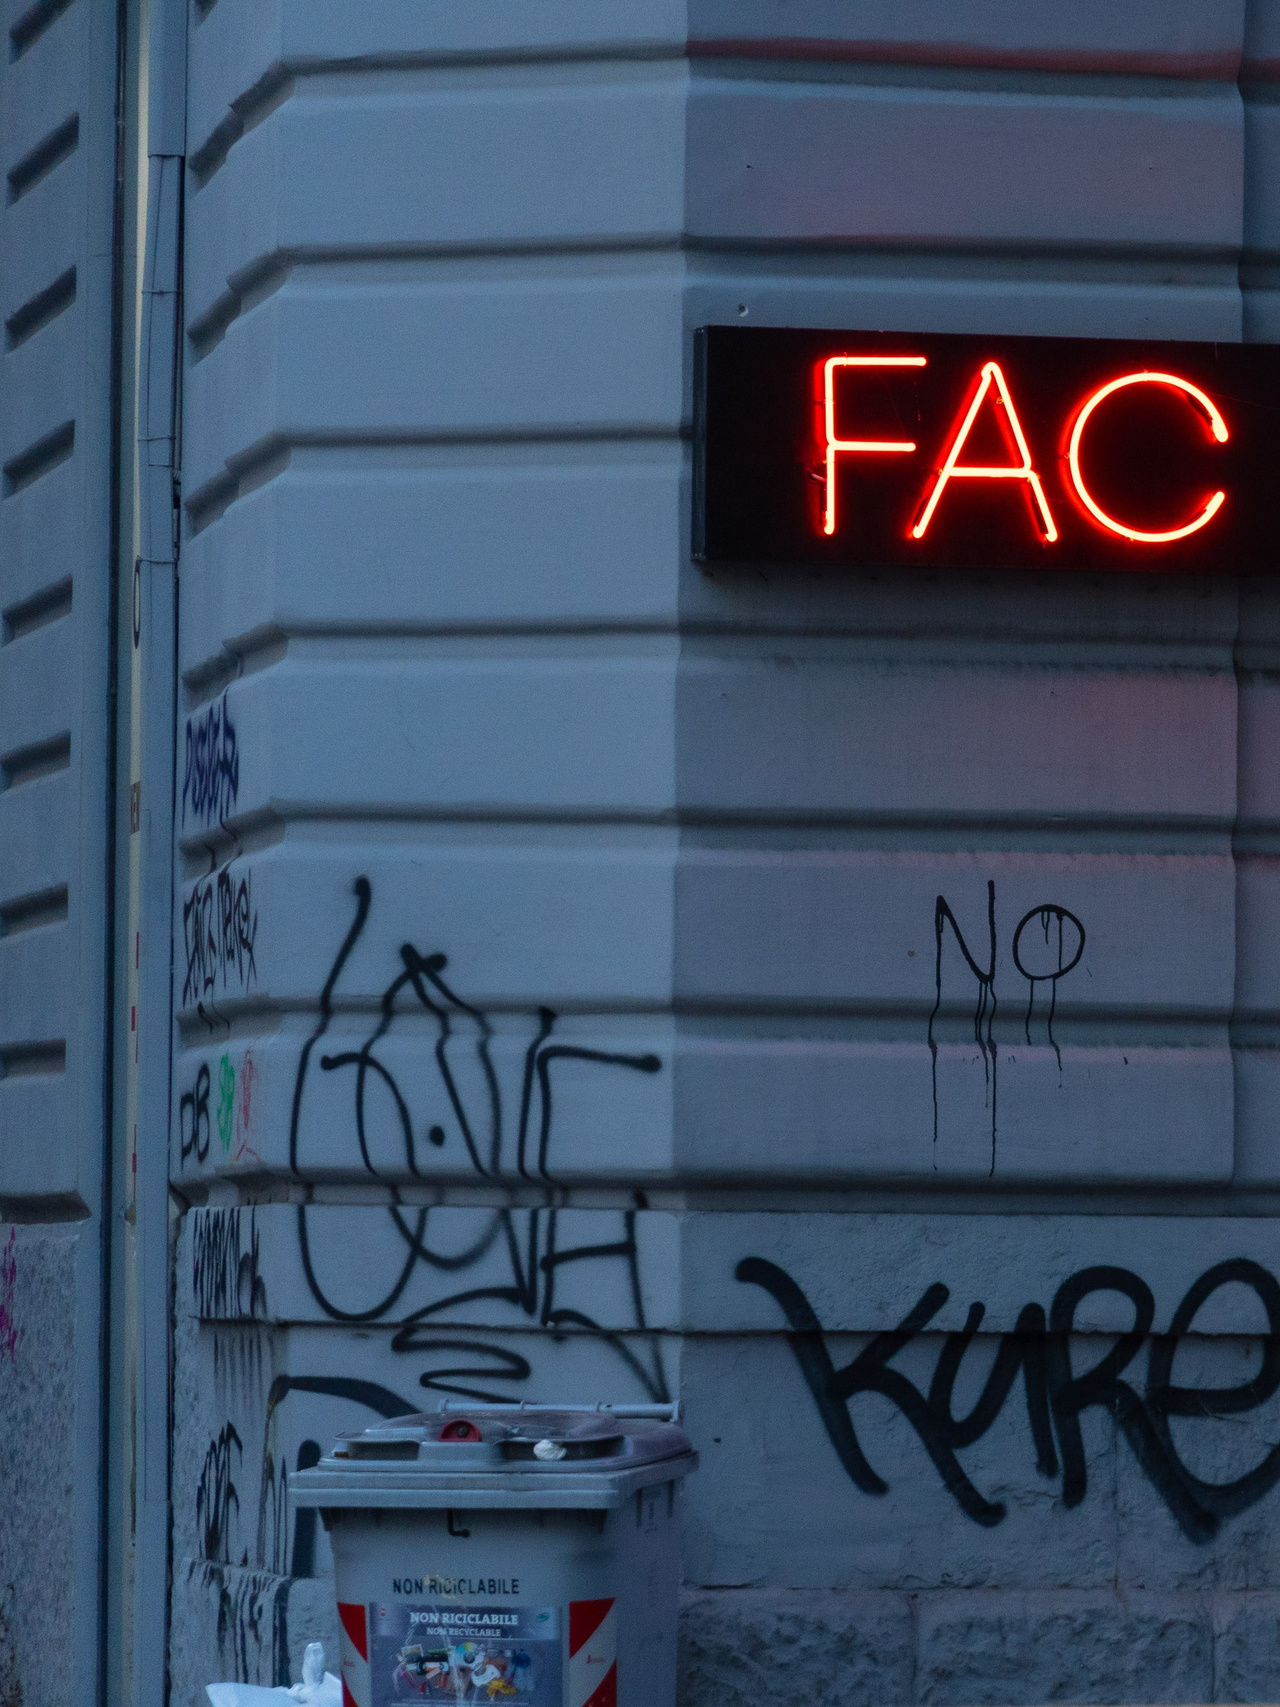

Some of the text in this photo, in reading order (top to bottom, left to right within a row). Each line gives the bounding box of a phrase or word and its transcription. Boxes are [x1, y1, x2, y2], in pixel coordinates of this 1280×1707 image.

[815, 355, 1229, 543] FAC
[933, 878, 1087, 986] NO
[392, 1578, 520, 1595] NON RICICLABILE
[409, 1612, 519, 1626] NON RICICLABILE
